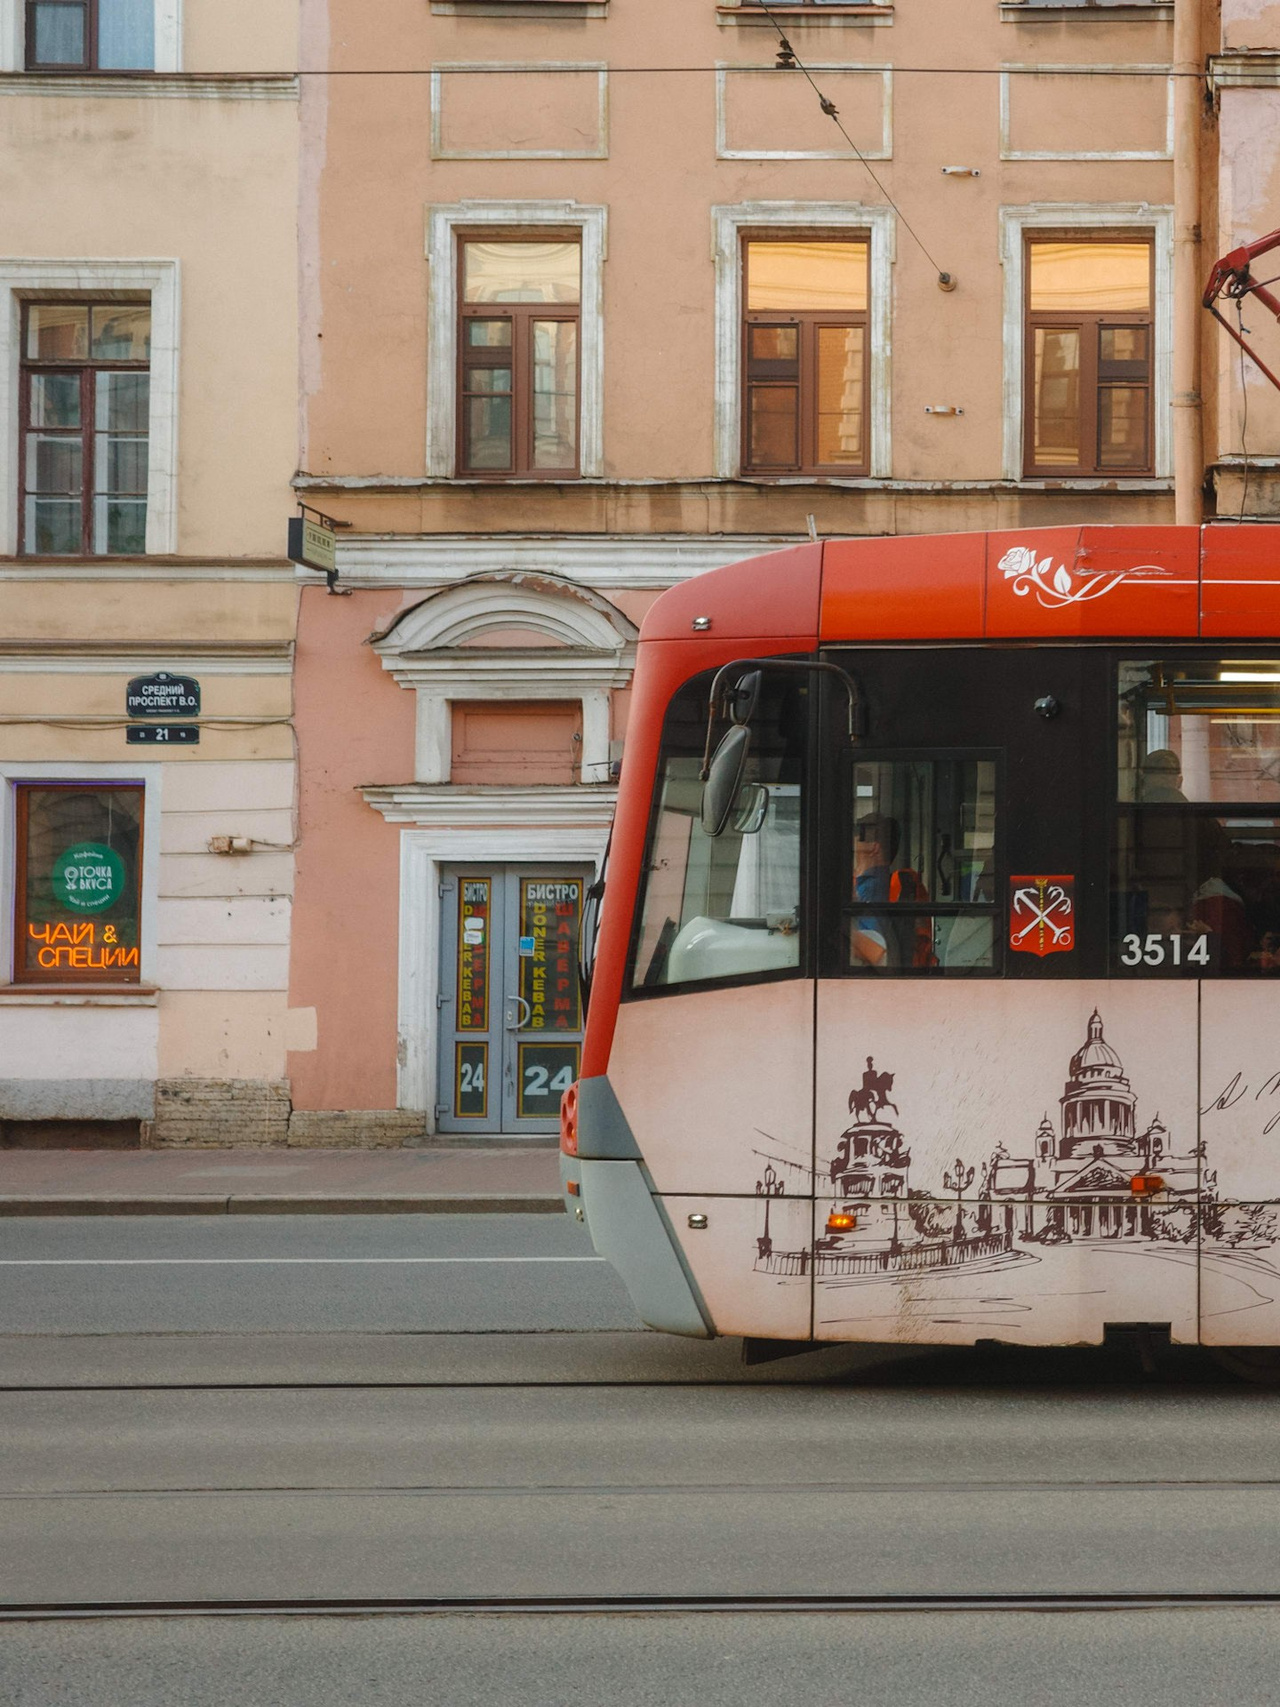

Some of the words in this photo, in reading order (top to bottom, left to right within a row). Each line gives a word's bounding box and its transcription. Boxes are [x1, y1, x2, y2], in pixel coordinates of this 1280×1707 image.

[129, 696, 178, 706] ПРОСПЕКТ
[179, 696, 198, 706] В.О.
[142, 684, 184, 696] СРЕДНИЙ
[156, 728, 169, 740] 21
[79, 866, 112, 878] ТОЧКА
[80, 878, 112, 890] ВКУСА
[527, 884, 578, 900] БИСТРО
[29, 922, 94, 945] ЧАЙ
[103, 924, 118, 944] &
[532, 902, 547, 962] DONER
[38, 946, 139, 970] СПЕЦИИ
[1121, 933, 1210, 966] 3514
[554, 902, 573, 1028] ШАВЕРМА
[462, 967, 473, 1025] KEBAB
[532, 967, 547, 1028] KEBAB
[461, 1063, 484, 1092] 24
[524, 1065, 573, 1095] 24
